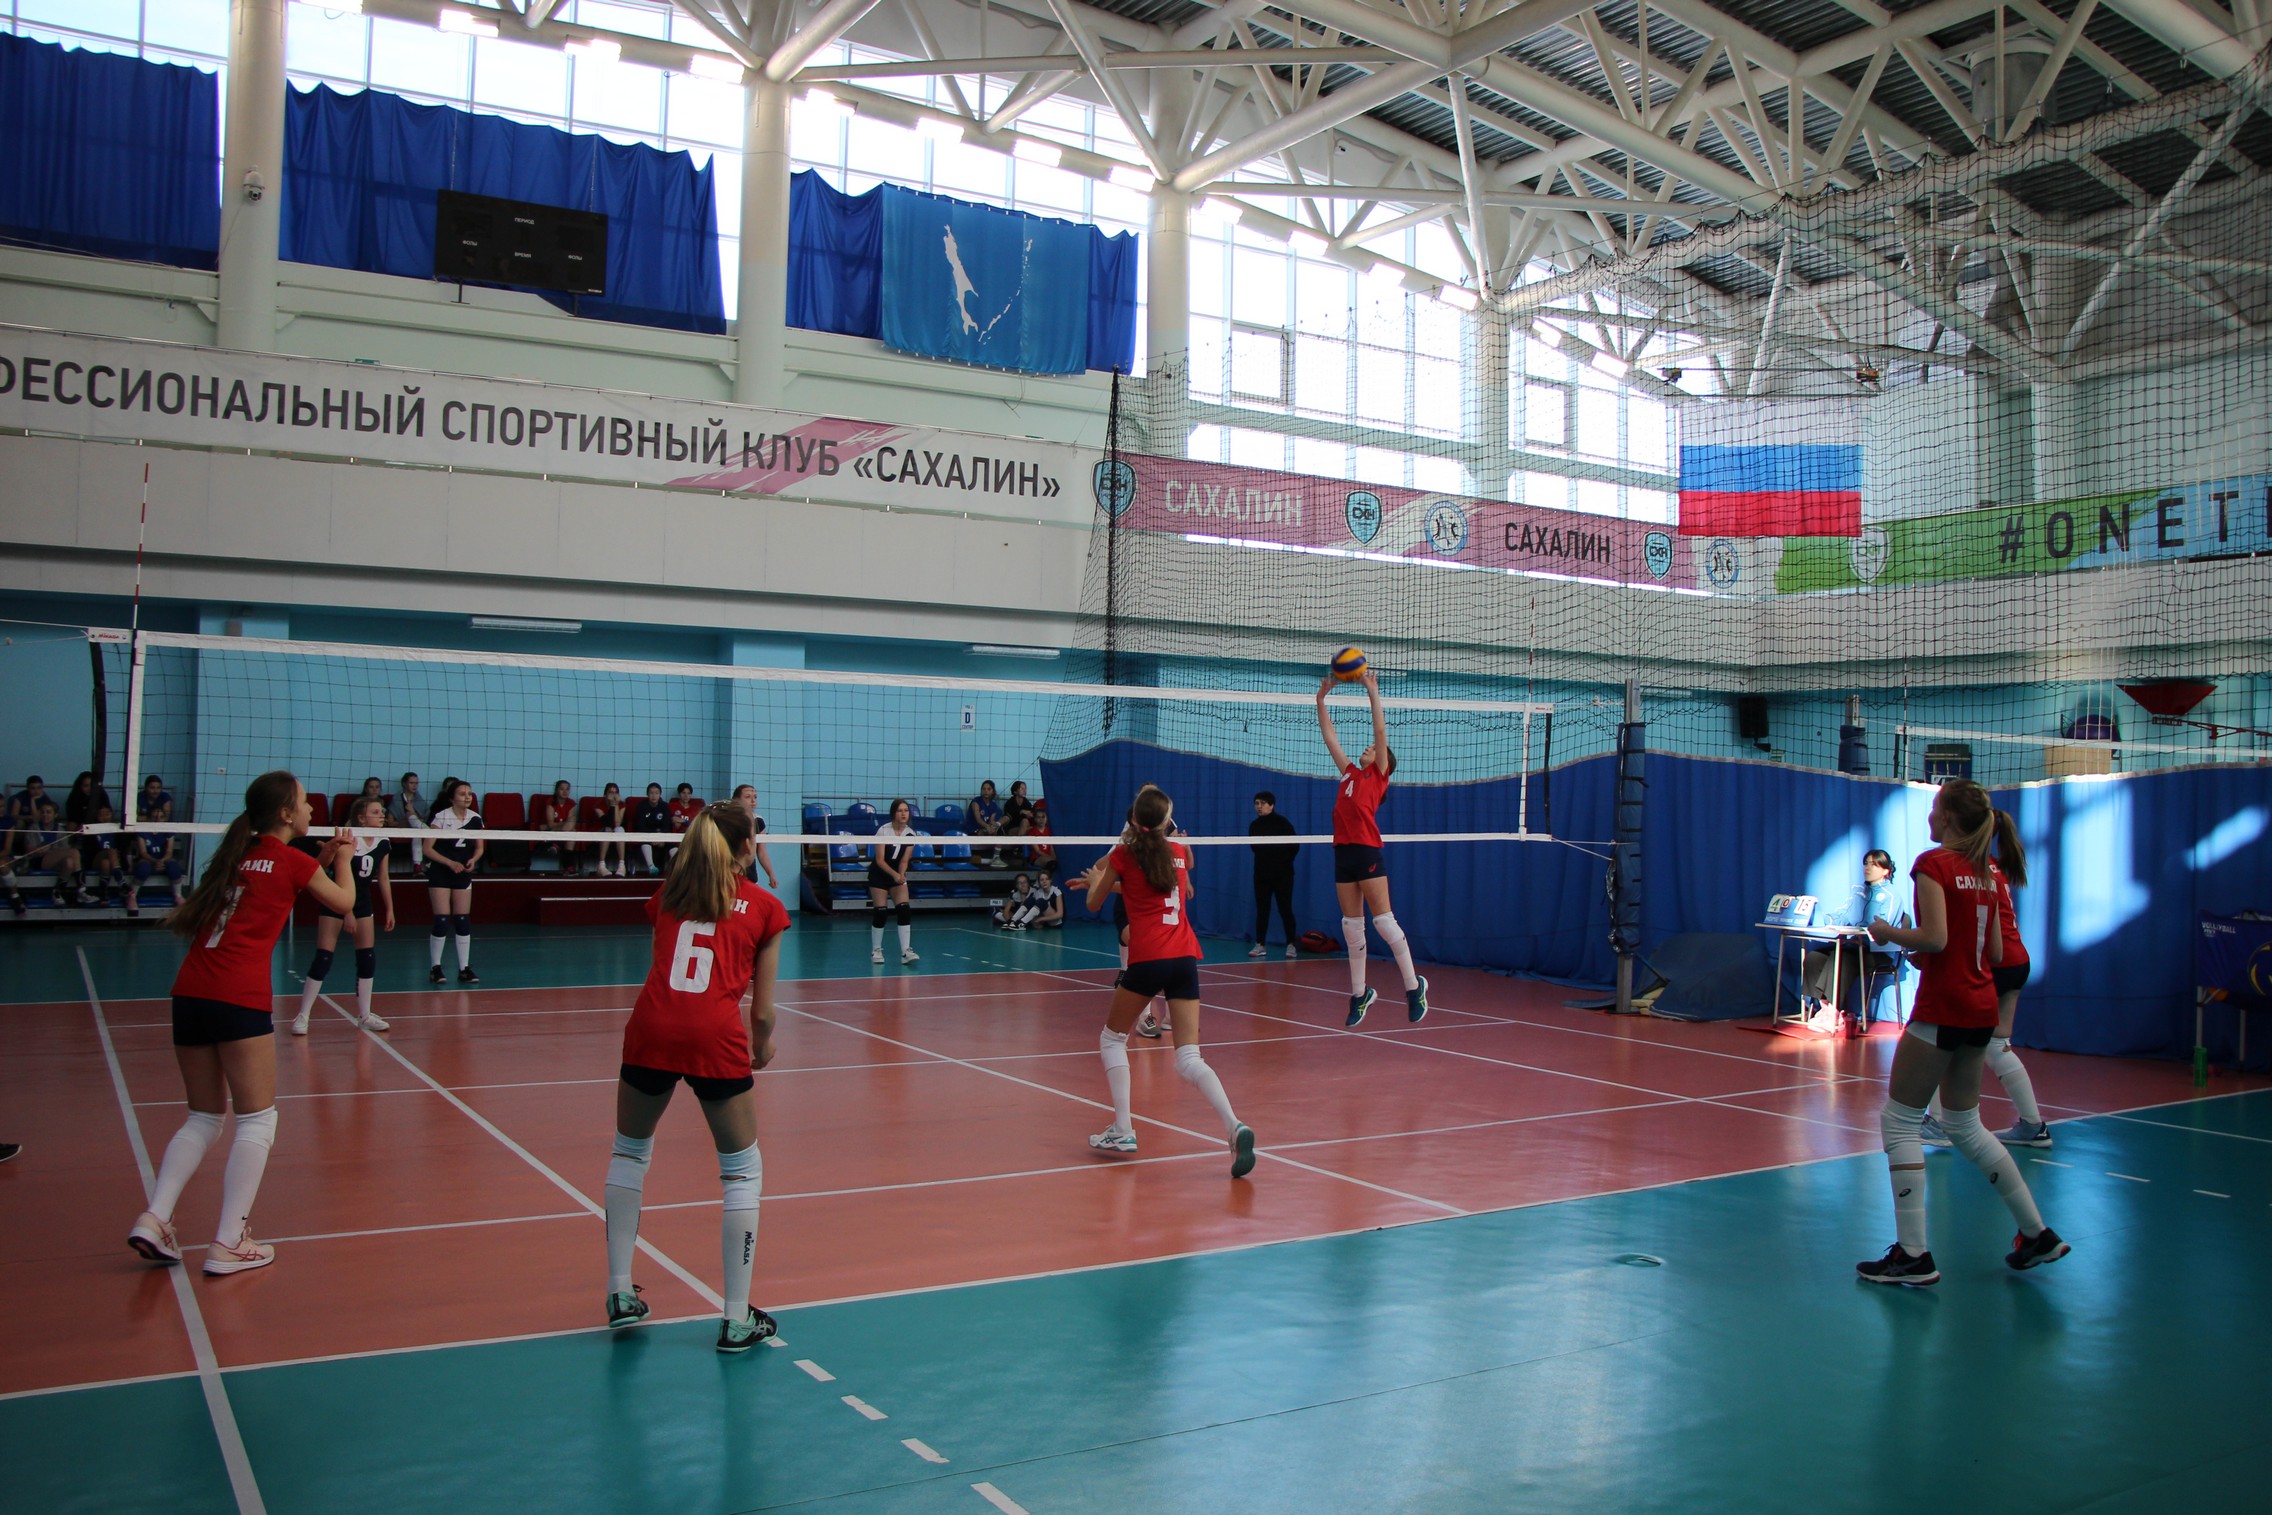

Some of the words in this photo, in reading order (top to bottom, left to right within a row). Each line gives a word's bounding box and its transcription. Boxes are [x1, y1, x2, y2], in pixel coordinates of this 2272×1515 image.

[441, 400, 728, 467] СПОРТИВНЫЙ
[742, 430, 840, 478] КЛУБ
[852, 446, 1062, 499] «САХАЛИН»
[1164, 479, 1304, 527] САХАЛИН
[2000, 485, 2272, 564] #ONET
[1504, 521, 1611, 564] САХАЛИН
[1344, 779, 1355, 798] 4
[358, 855, 374, 878] 9
[1162, 885, 1181, 926] 3
[669, 920, 717, 994] 6
